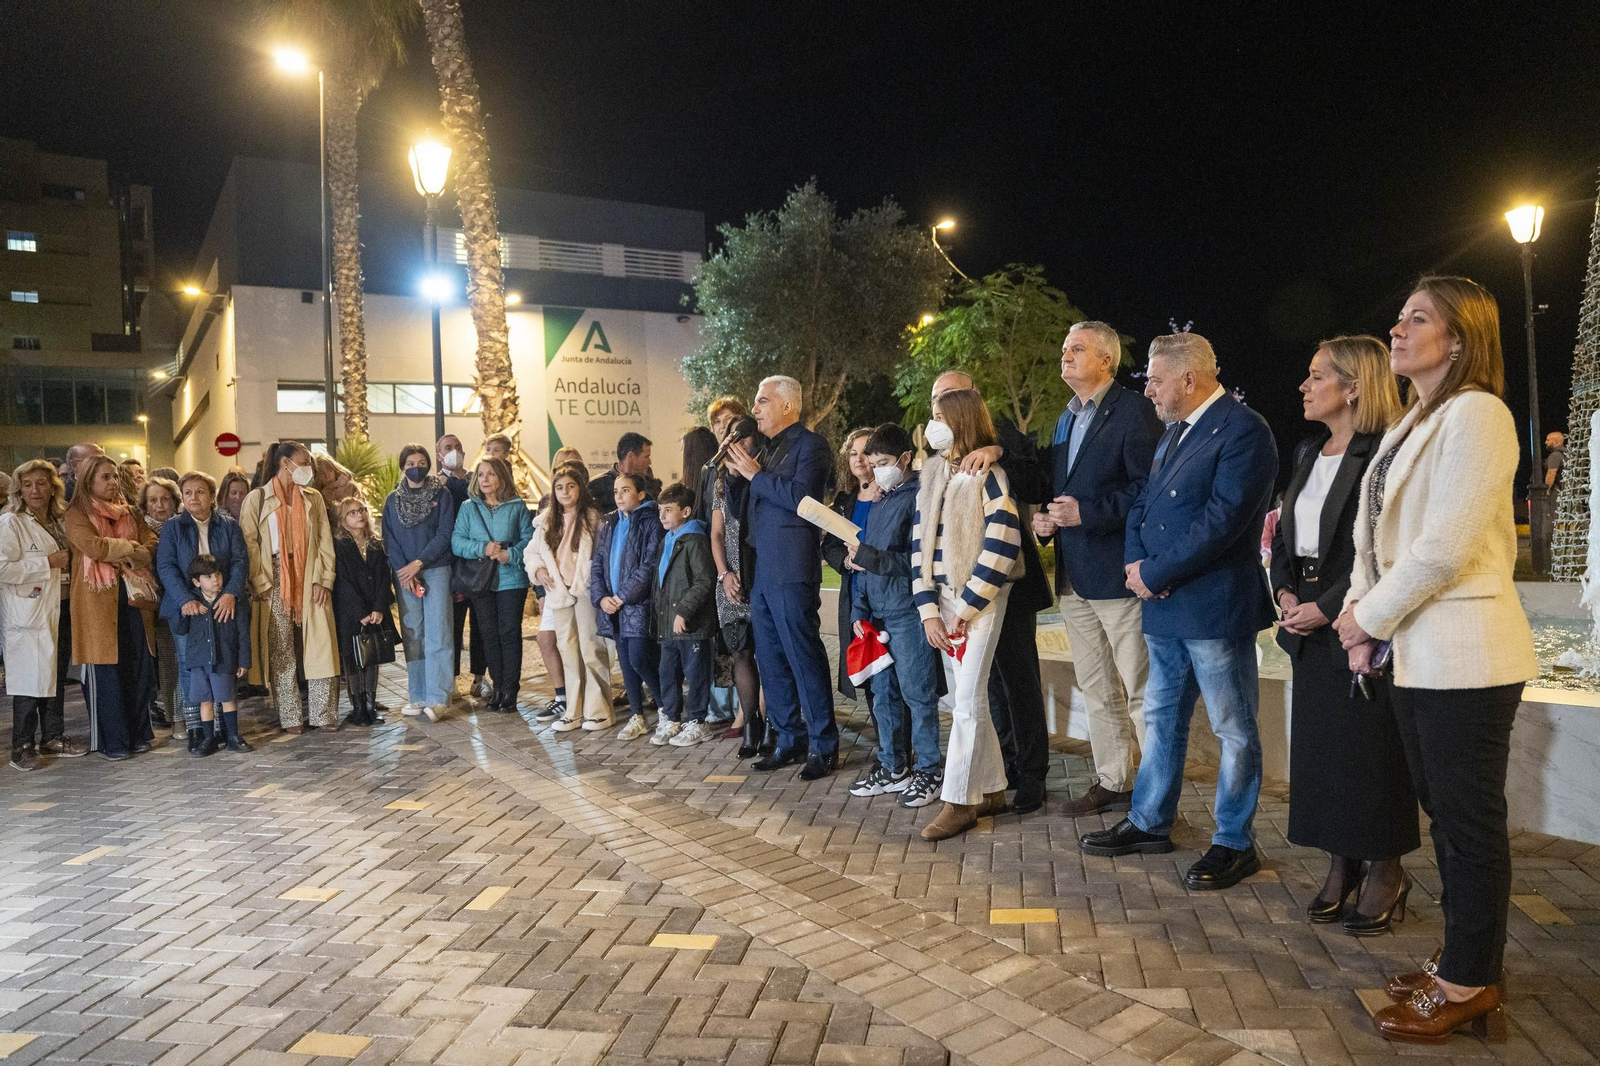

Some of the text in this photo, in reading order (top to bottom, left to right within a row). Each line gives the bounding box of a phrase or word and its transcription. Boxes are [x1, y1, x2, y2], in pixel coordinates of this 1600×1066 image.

[561, 355, 632, 365] Junta de Andalucía
[554, 377, 641, 396] Andalucía
[555, 399, 641, 416] TE CUIDA
